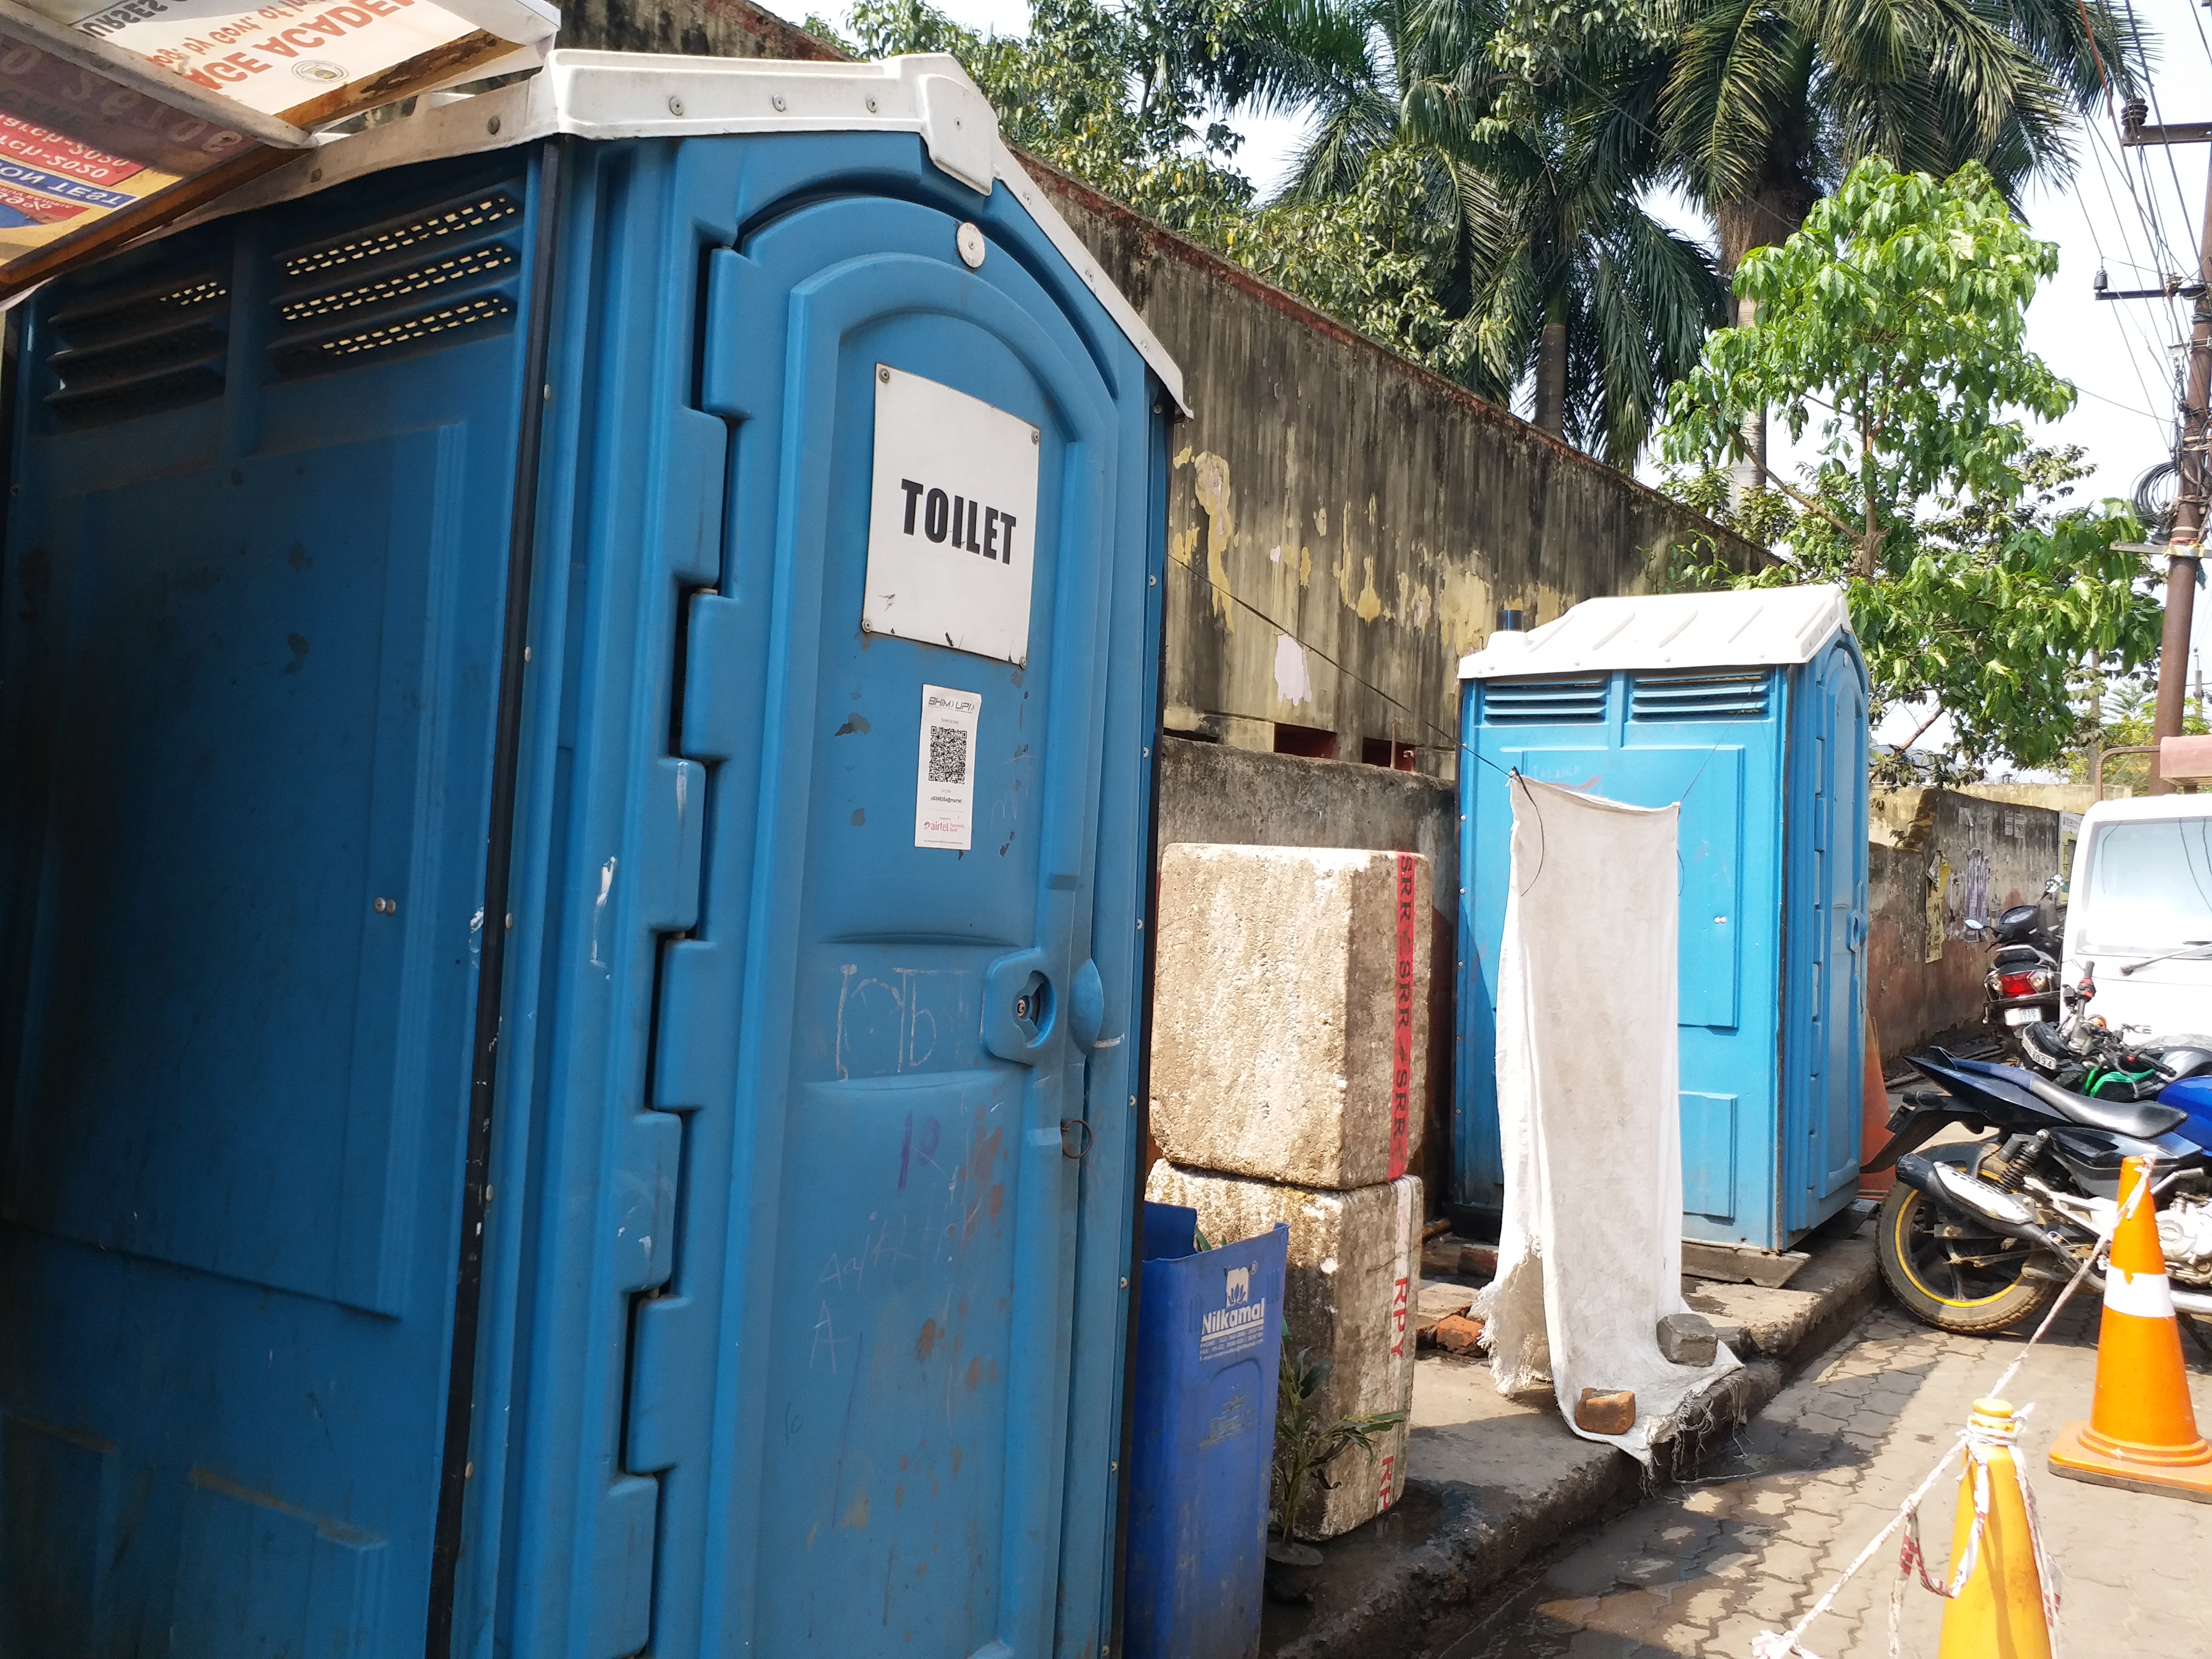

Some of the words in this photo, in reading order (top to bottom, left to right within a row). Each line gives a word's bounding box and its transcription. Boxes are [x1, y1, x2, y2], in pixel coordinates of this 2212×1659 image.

[901, 478, 1016, 565] TOILET
[928, 697, 951, 708] BHIM
[931, 821, 949, 832] airtel
[1400, 854, 1413, 924] SRR
[1398, 960, 1410, 1029] SRR
[1393, 1069, 1407, 1140] SRR
[1202, 1297, 1265, 1335] Nilkamal
[1390, 1277, 1408, 1358] RPY
